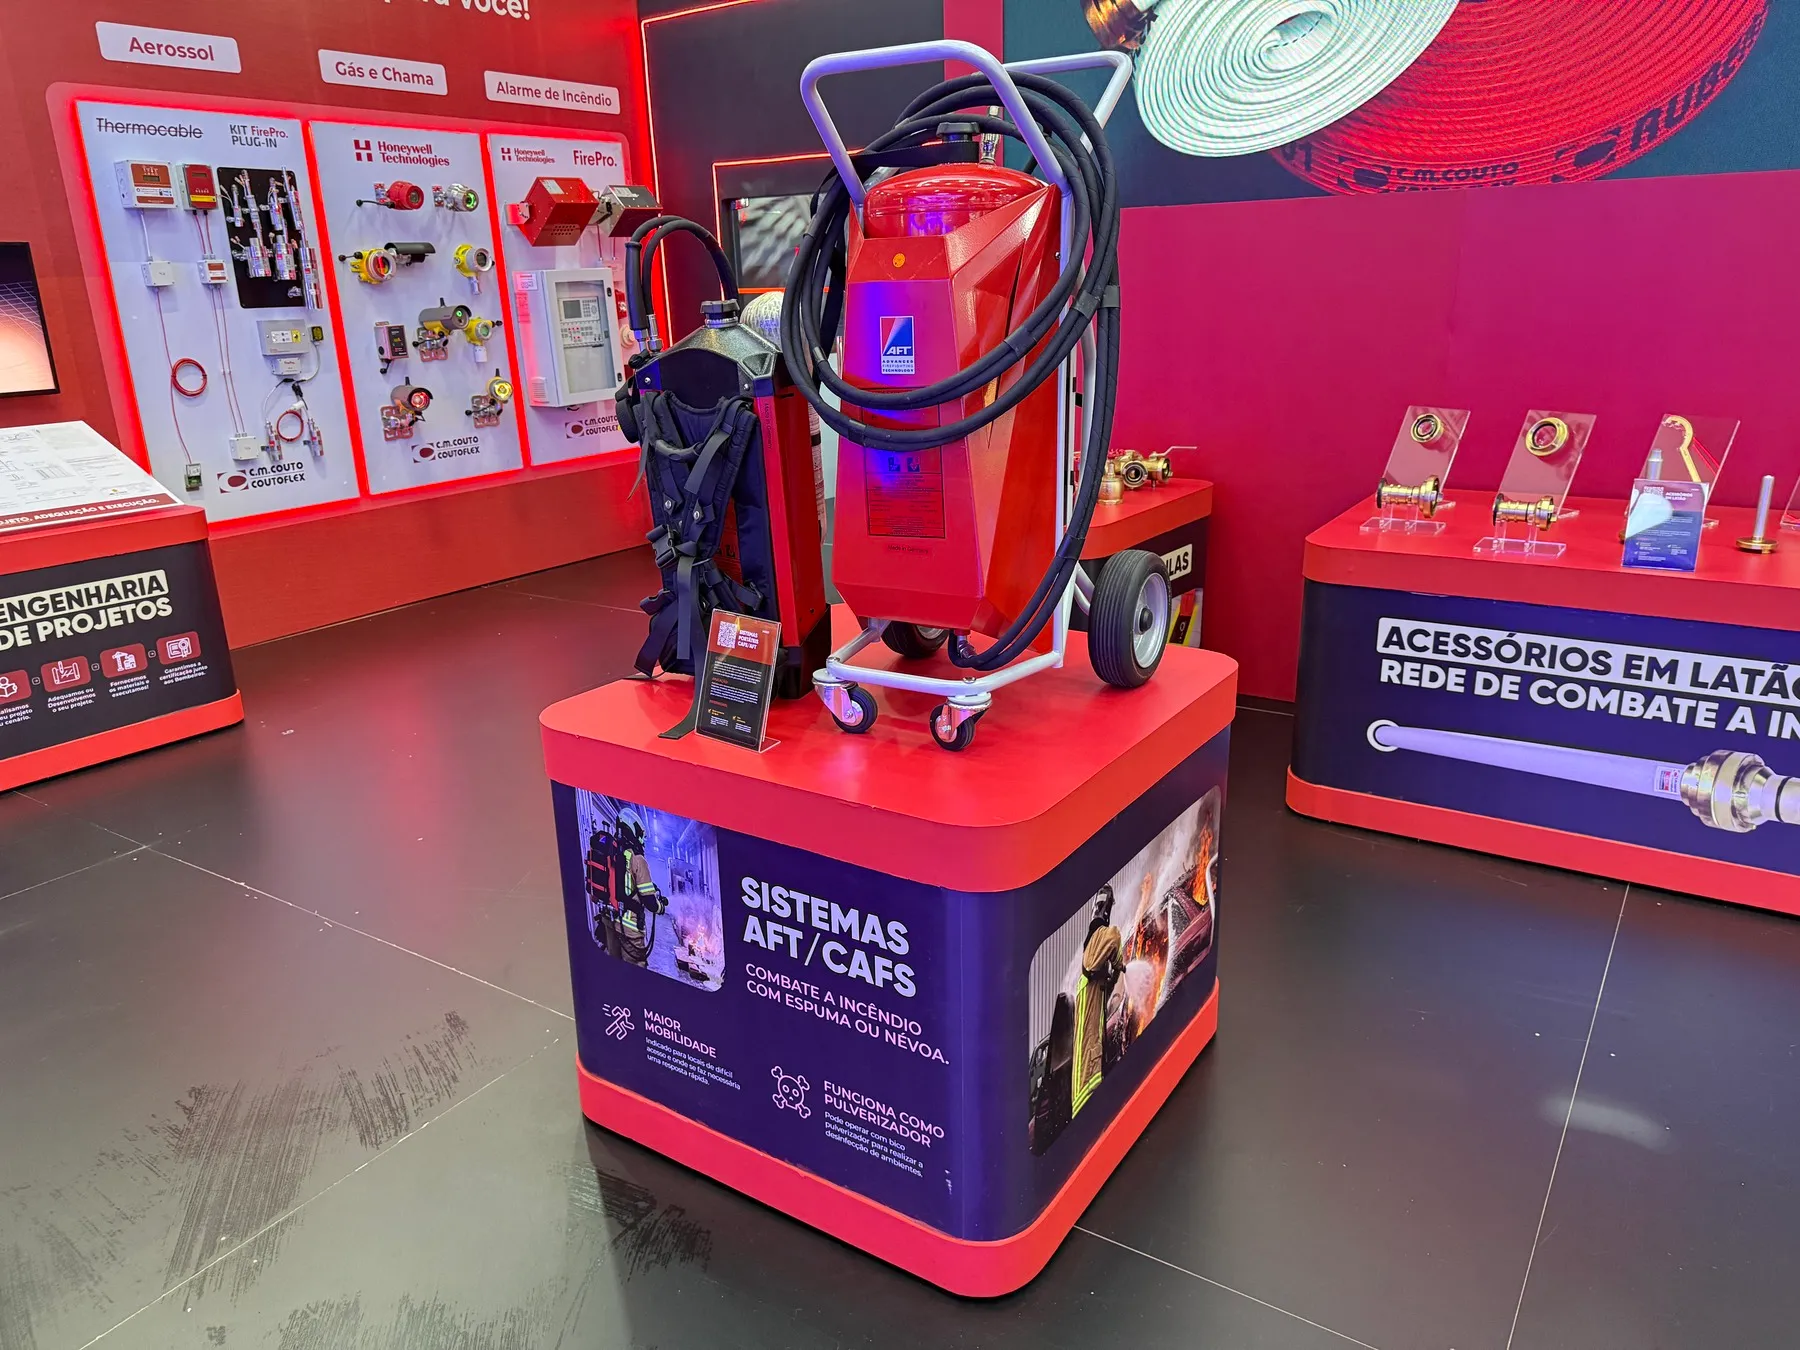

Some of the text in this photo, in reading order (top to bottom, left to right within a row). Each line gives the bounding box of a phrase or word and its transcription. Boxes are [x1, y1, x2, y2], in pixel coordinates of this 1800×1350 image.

[129, 36, 214, 62] Aerossol
[334, 61, 434, 86] Gás e Chama
[496, 80, 612, 107] Alarme de Incêndio
[96, 118, 204, 138] Thermocable
[229, 124, 289, 138] KIT FirePro.
[232, 136, 278, 148] PLUG-IN
[378, 140, 432, 155] Honeywell
[380, 152, 450, 168] Technologies
[514, 148, 546, 157] Honeywell
[516, 154, 556, 165] Technologies
[573, 150, 618, 166] FirePro.
[886, 346, 912, 355] AFT
[436, 436, 479, 448] C.M.COUTO
[438, 446, 480, 459] COUTOFLEX
[249, 462, 304, 476] C.M.COUTO
[251, 473, 306, 488] COUTOFLEX
[34, 506, 98, 520] ADEQUAÇÃO
[0, 597, 173, 650] DE PROJETOS
[1382, 626, 1612, 676] ACESSÓRIOS
[1622, 653, 1680, 685] EM
[159, 665, 208, 681] certificação junto
[164, 662, 197, 674] Garantimos
[110, 675, 147, 687] Fornecemos
[117, 681, 145, 691] materiais
[47, 690, 85, 702] Adequamos
[111, 685, 149, 698] executamos!
[1380, 658, 1467, 693] REDE
[1474, 670, 1522, 700] DE
[1529, 678, 1720, 729] COMBATE
[1725, 706, 1757, 735] A
[0, 704, 29, 714] alisamos
[48, 693, 96, 709] Desenvolvemos
[58, 704, 70, 712] seu
[70, 700, 94, 710] projeto.
[9, 709, 33, 720] projeto
[741, 876, 910, 956] SISTEMAS
[746, 963, 922, 1036] COMBATE A INCÊNDIO
[644, 1008, 682, 1032] MAIOR
[746, 980, 950, 1065] COM ESPUMA OU NÉVOA.
[645, 1021, 717, 1058] MOBILIDADE
[646, 1037, 733, 1078] Indicado para locais de difícil
[646, 1046, 667, 1059] acesso
[672, 1056, 688, 1069] onde
[697, 1065, 707, 1076] faz
[707, 1071, 741, 1090] necessária
[647, 1054, 710, 1086] uma resposta rápida.
[824, 1080, 945, 1138] FUNCIONA COMO
[824, 1094, 931, 1148] PULVERIZADOR
[824, 1111, 906, 1151] Pode operar com bico
[825, 1122, 870, 1144] pulverizador
[871, 1140, 888, 1154] para
[889, 1148, 918, 1165] realizar
[825, 1130, 923, 1178] desinfecção de ambientes.
